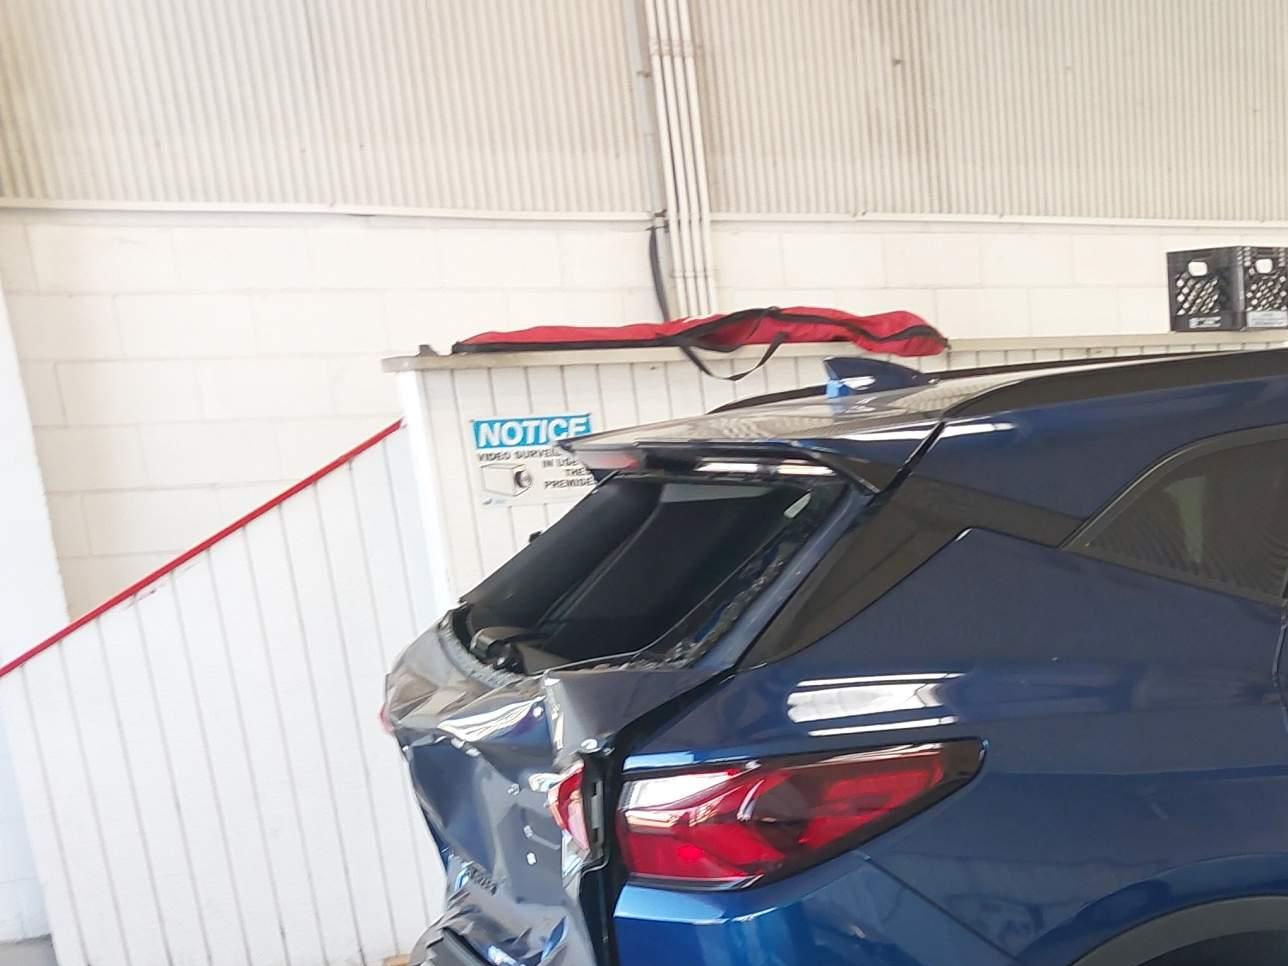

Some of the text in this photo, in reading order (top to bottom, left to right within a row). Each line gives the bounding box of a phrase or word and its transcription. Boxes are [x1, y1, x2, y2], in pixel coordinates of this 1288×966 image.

[480, 418, 587, 446] NOTICE
[479, 451, 511, 462] VIDEO
[543, 459, 555, 469] IN
